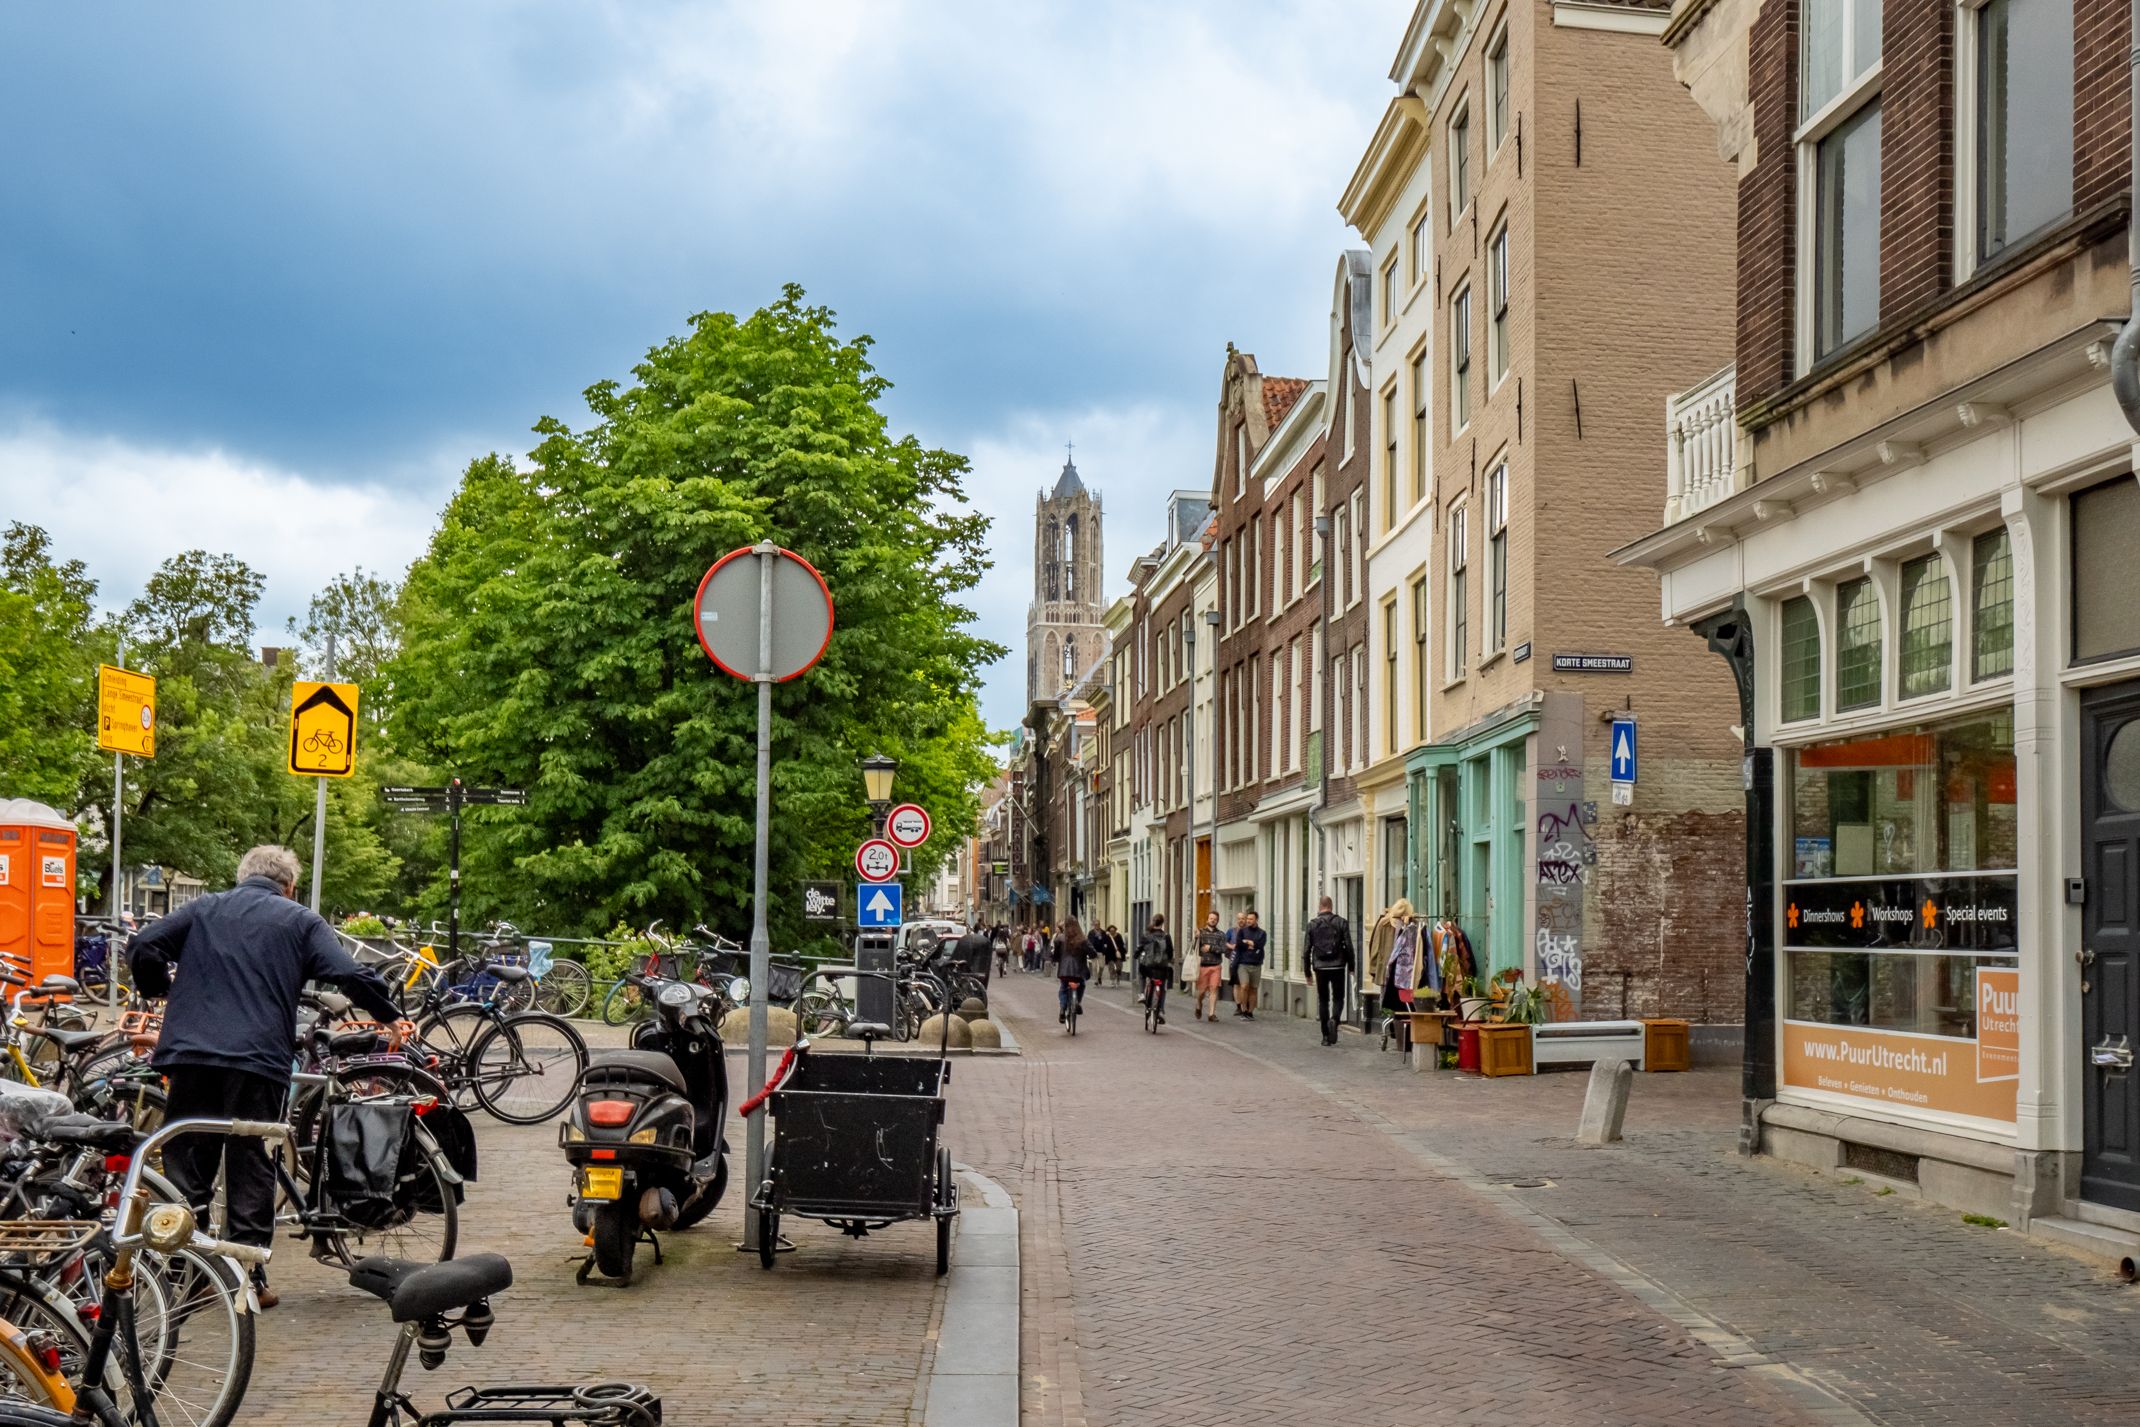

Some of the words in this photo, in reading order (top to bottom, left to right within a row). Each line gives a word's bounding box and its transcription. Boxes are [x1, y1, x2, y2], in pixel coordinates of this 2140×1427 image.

[1556, 657, 1581, 667] KORTE
[1582, 658, 1631, 669] SMEESTRAAT
[318, 753, 328, 767] 2
[806, 887, 820, 899] de
[1803, 907, 1845, 923] Dinnershows
[1872, 905, 1913, 926] Workshops
[1946, 904, 1977, 926] Special
[1977, 906, 2008, 921] events
[1803, 1040, 1948, 1076] www.PuurUtrecht.nl
[1818, 1075, 1843, 1089] Beleven
[1850, 1080, 1880, 1096] Genieten
[1887, 1086, 1929, 1104] Onthouden
